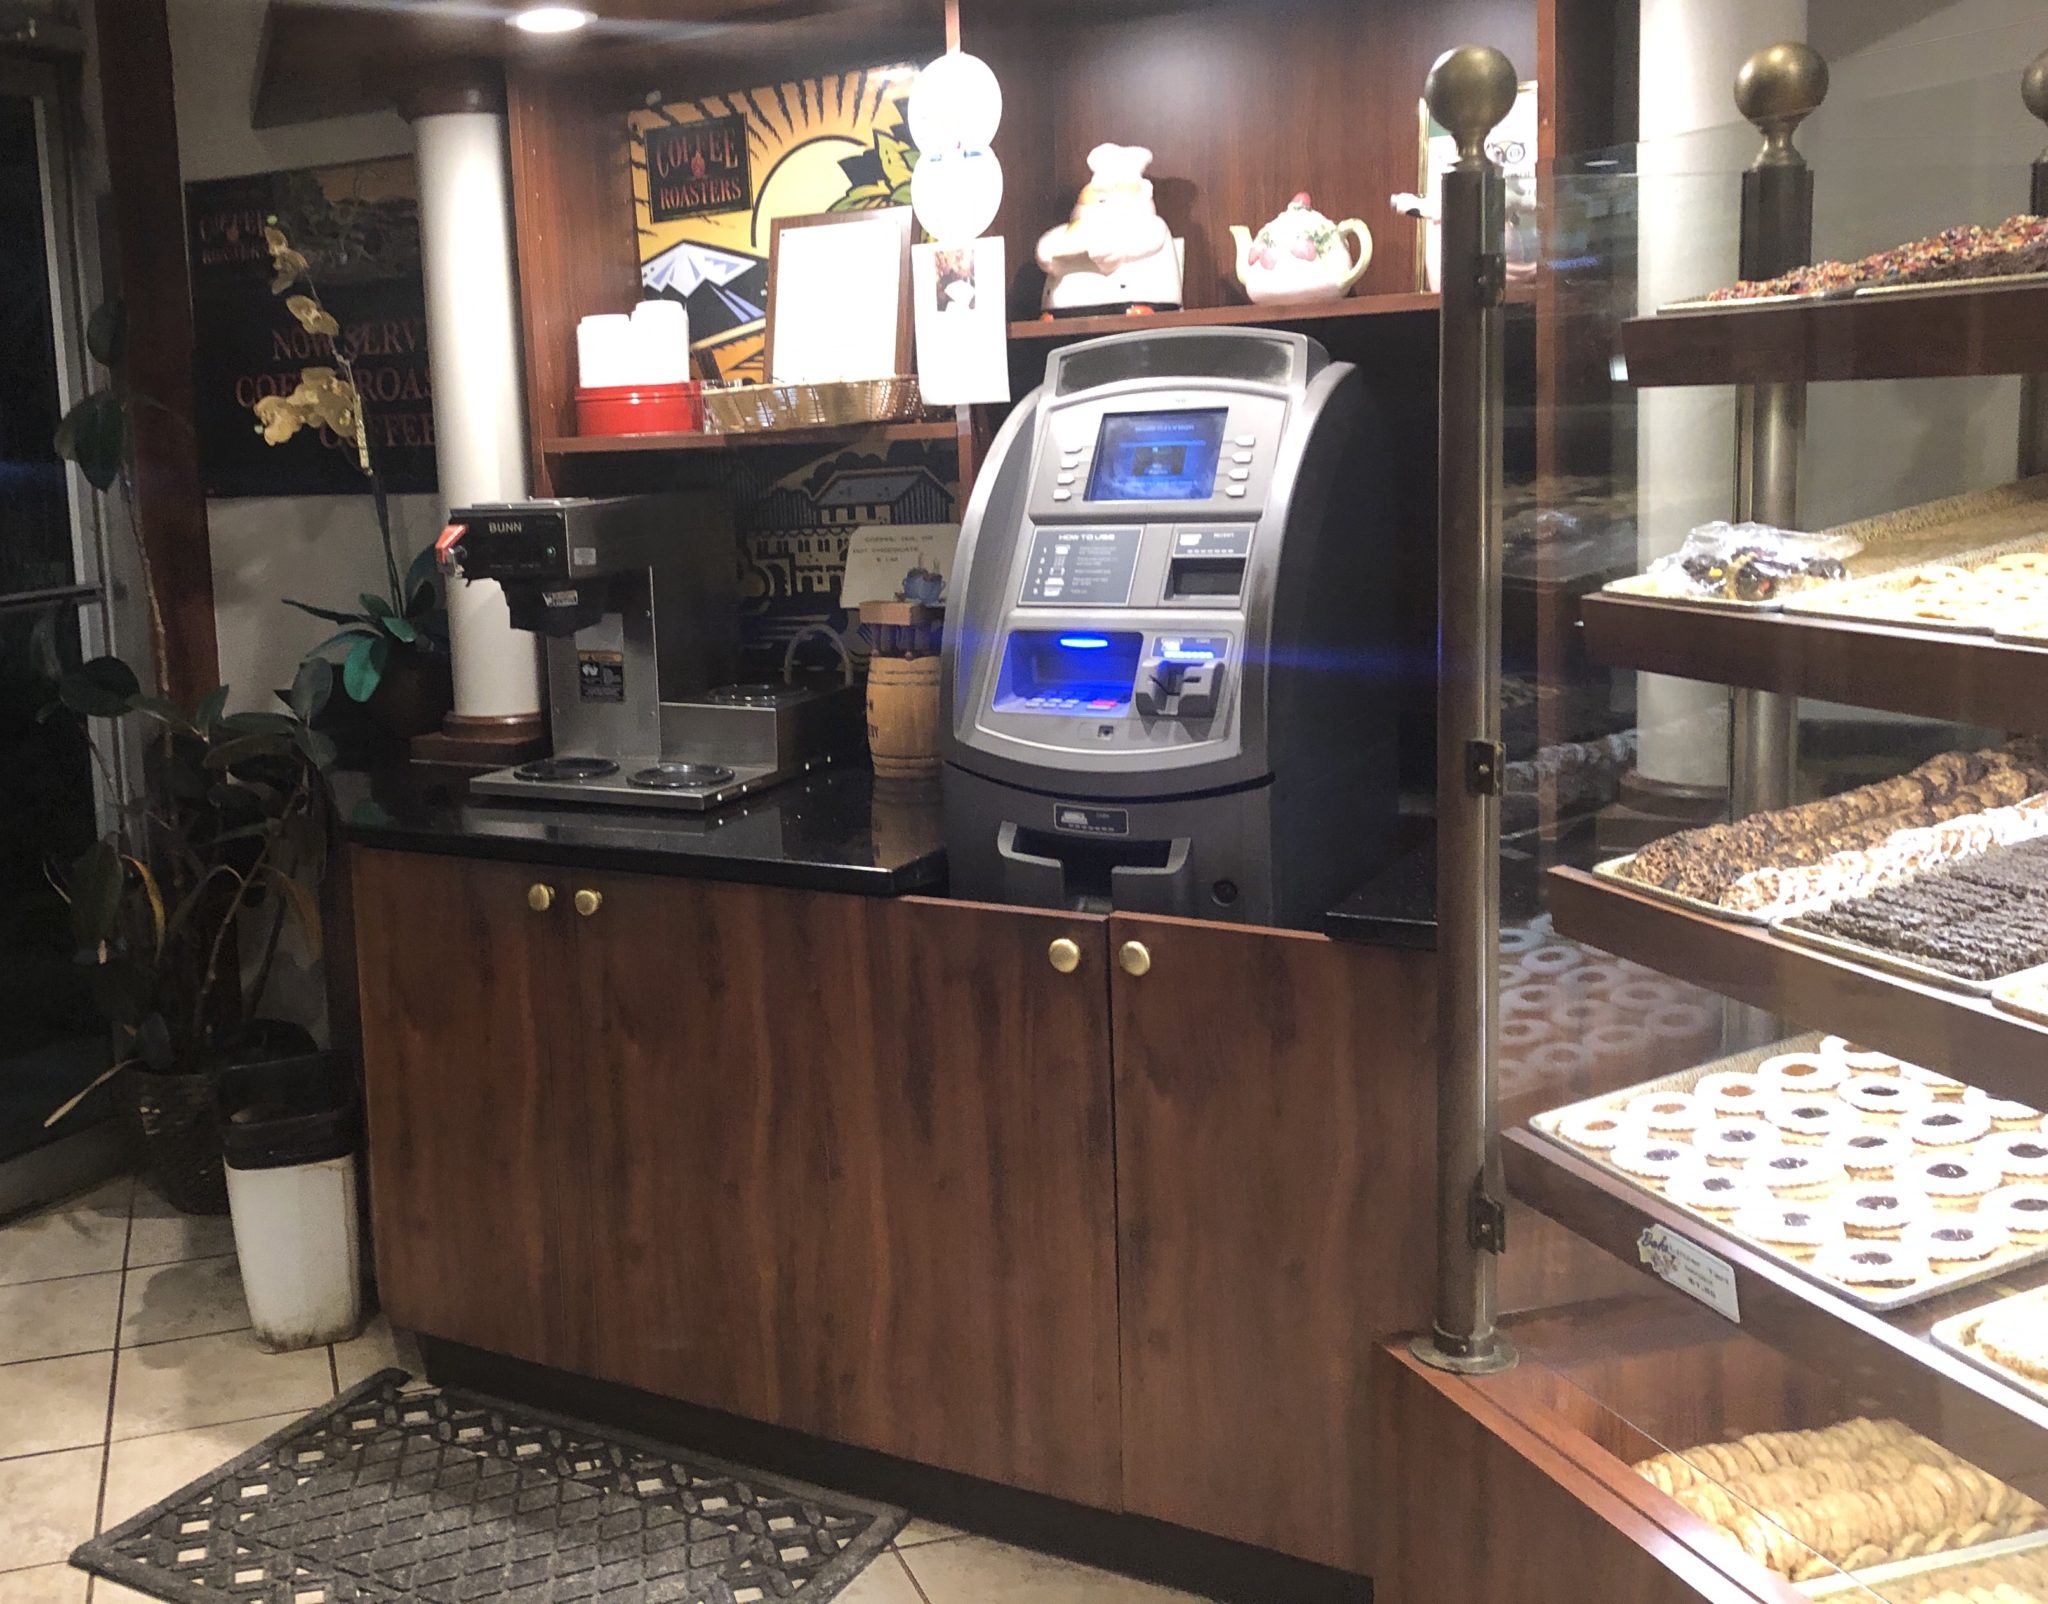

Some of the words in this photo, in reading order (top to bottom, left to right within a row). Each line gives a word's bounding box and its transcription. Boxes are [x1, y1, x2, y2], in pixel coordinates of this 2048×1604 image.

[660, 179, 742, 210] ROASTERS
[345, 318, 427, 363] SERV
[355, 366, 432, 402] ROA
[489, 521, 522, 533] BUNN
